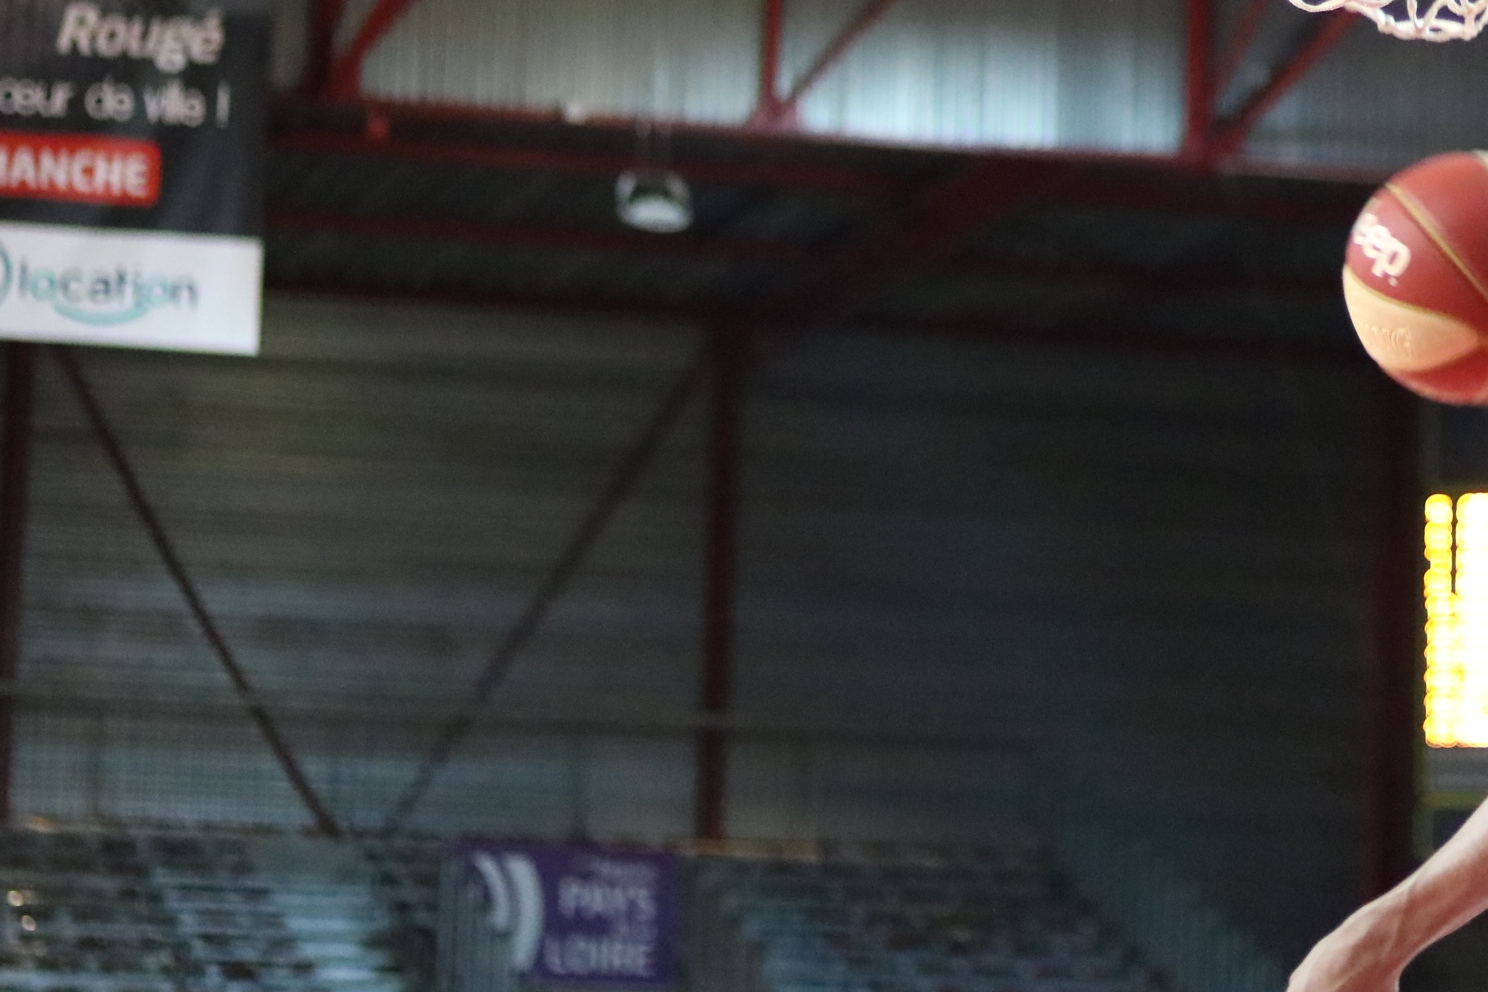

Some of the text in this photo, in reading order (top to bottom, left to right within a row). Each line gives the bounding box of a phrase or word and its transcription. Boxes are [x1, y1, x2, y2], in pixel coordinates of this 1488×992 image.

[55, 0, 225, 74] Rougé
[84, 75, 135, 122] de
[143, 78, 207, 127] ville
[1353, 211, 1412, 279] eep
